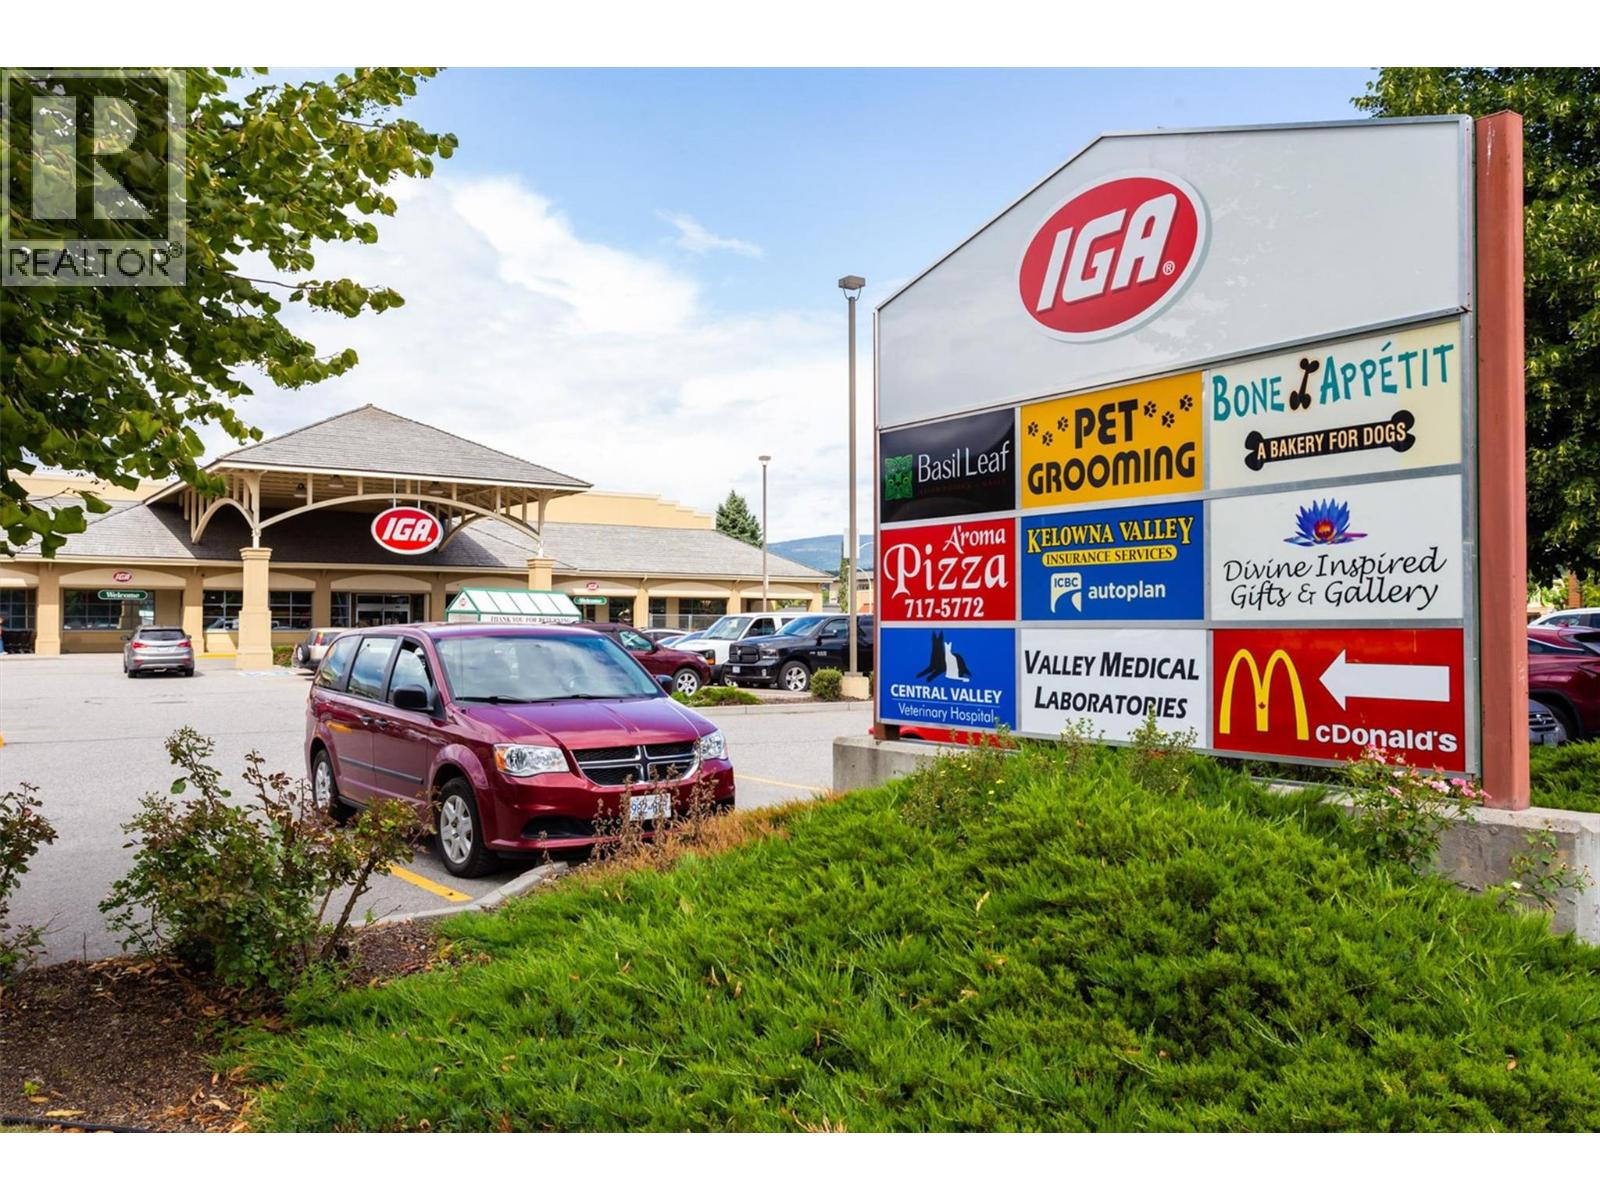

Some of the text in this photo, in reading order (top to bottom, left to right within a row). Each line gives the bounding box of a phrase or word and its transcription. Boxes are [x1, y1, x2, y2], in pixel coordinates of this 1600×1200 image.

[1213, 341, 1454, 421] BONE APPÉTIT
[1075, 399, 1139, 449] PET
[1257, 421, 1407, 460] A BAKERY FOR DOGS
[918, 440, 1010, 483] Basil Leaf
[1027, 441, 1196, 496] GROOMING
[1027, 516, 1194, 553] KELOWNA VALLEY
[883, 543, 1009, 600] Pizza
[1046, 546, 1173, 565] INSURANCE SERVICES
[1224, 546, 1448, 583] Divine Inspired
[904, 596, 985, 618] 717-5772
[1054, 577, 1167, 602] ICBC autoplan
[1231, 577, 1439, 611] Gifts & Gallery
[1025, 650, 1200, 681] VALLEY MEDICAL
[890, 683, 1002, 704] CENTRAL VALLEY
[1034, 686, 1188, 719] LABORATORIES
[898, 702, 994, 724] Veterinary Hospital
